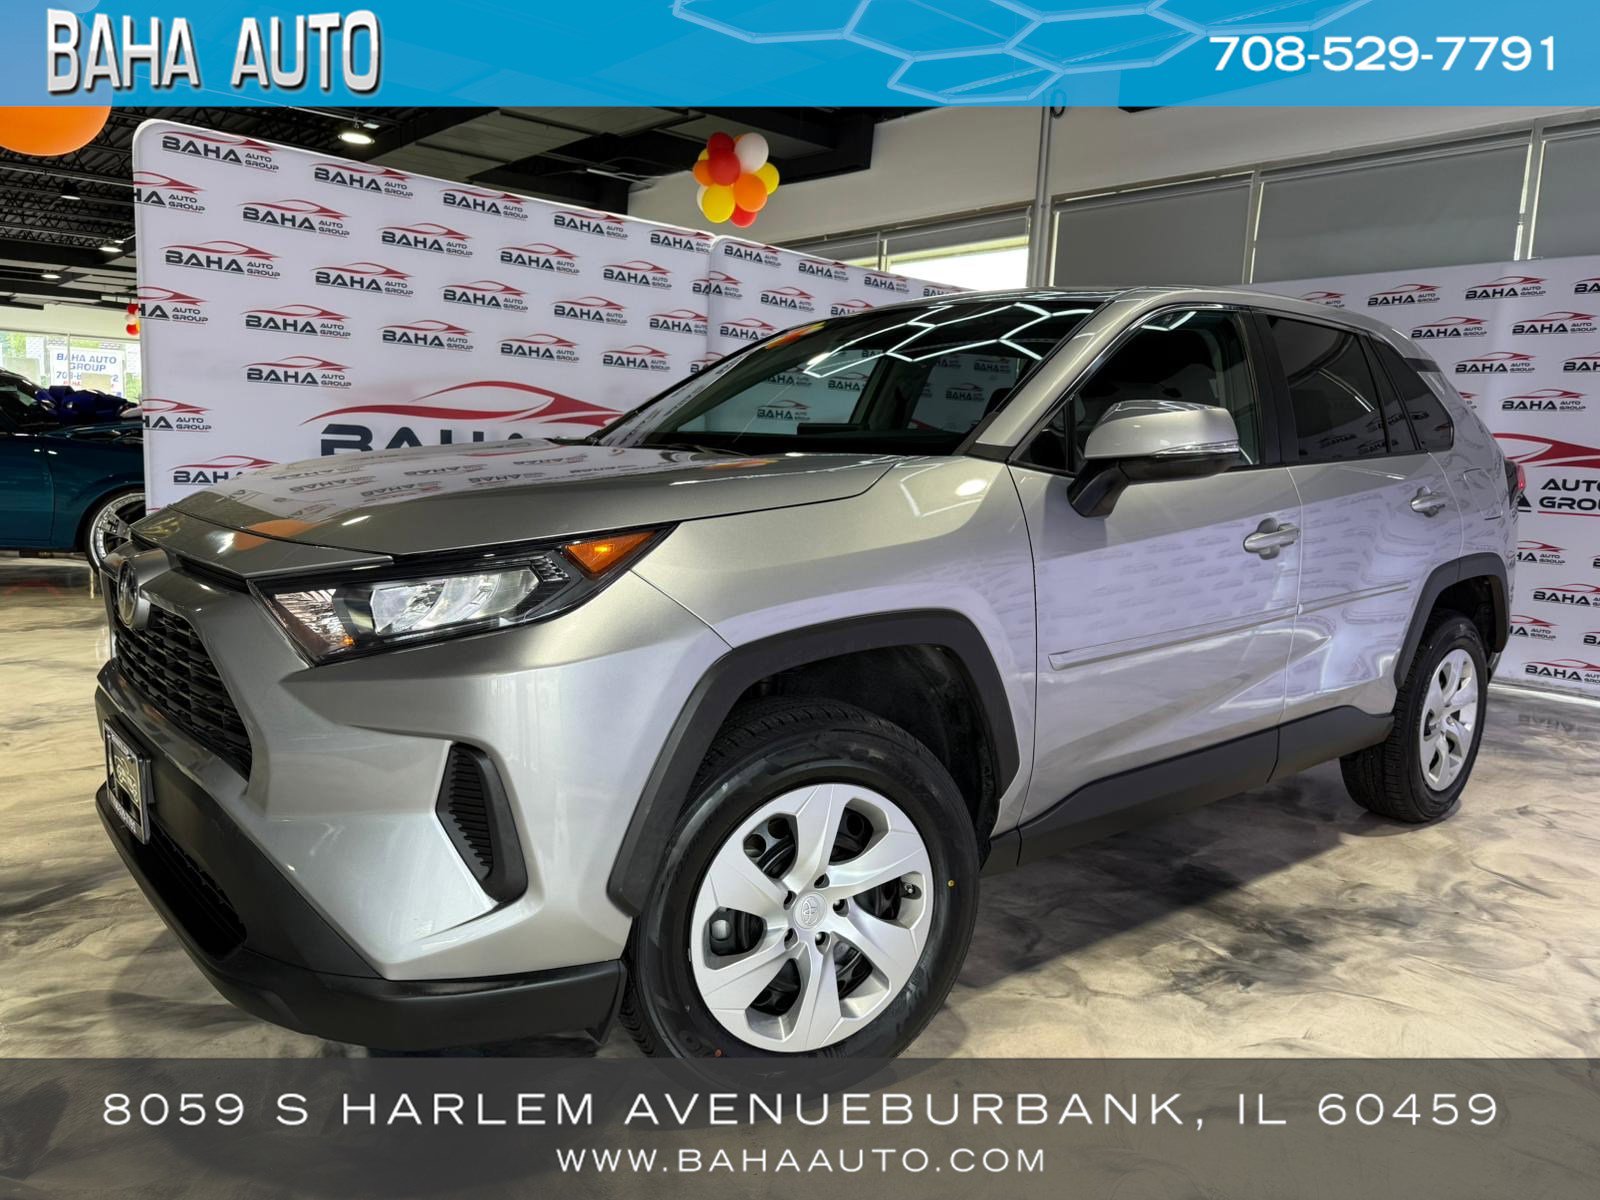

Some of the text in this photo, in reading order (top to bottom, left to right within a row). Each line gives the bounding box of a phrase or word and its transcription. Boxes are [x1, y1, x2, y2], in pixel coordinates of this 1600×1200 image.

[163, 136, 242, 163] BAHA
[245, 153, 272, 162] AUTO
[245, 160, 279, 171] GROUP
[314, 167, 382, 191] BAHA
[384, 182, 407, 190] AUTO
[384, 188, 413, 197] GROUP
[168, 194, 197, 203] AUTO
[443, 193, 501, 214] BAHA
[168, 202, 205, 213] GROUP
[243, 207, 316, 231] BAHA
[503, 211, 528, 220] GROUP
[318, 220, 343, 229] AUTO
[554, 215, 604, 234] BAHA
[318, 227, 349, 236] GROUP
[606, 231, 628, 239] GROUP
[382, 231, 444, 251] BAHA
[650, 233, 694, 250] BAHA
[446, 248, 472, 256] GROUP
[724, 245, 763, 263] BAHA
[165, 250, 244, 272] BAHA
[247, 261, 273, 270] AUTO
[501, 251, 554, 270] BAHA
[557, 260, 575, 268] AUTO
[247, 268, 280, 278] GROUP
[556, 266, 580, 274] GROUP
[798, 262, 832, 278] BAHA
[315, 271, 382, 291] BAHA
[604, 268, 650, 285] BAHA
[864, 276, 894, 291] BAHA
[1574, 283, 1600, 293] BA
[384, 287, 413, 296] GROUP
[1465, 287, 1518, 299] BAHA
[444, 289, 501, 307] BAHA
[761, 294, 797, 309] BAHA
[1368, 294, 1416, 306] BAHA
[172, 307, 200, 315] AUTO
[503, 303, 528, 311] GROUP
[172, 314, 208, 322] GROUP
[554, 305, 604, 322] BAHA
[245, 314, 317, 334] BAHA
[650, 318, 692, 332] BAHA
[1512, 323, 1568, 334] BAHA
[320, 330, 351, 338] GROUP
[720, 323, 758, 340] BAHA
[1411, 327, 1462, 338] BAHA
[383, 330, 444, 347] BAHA
[501, 343, 554, 359] BAHA
[89, 356, 117, 364] AUTO
[603, 354, 648, 369] BAHA
[1455, 363, 1508, 373] BAHA
[1563, 362, 1600, 371] BAH
[247, 368, 319, 385] BAHA
[321, 380, 352, 388] GROUP
[828, 380, 860, 391] BAHA
[1502, 400, 1557, 410] BAHA
[176, 416, 204, 424] AUTO
[757, 409, 793, 420] BAHA
[176, 423, 212, 431] GROUP
[173, 471, 242, 484] BAH
[1541, 478, 1600, 493] AUT
[1539, 497, 1600, 511] GRO
[1533, 591, 1590, 605] BAHA
[1525, 665, 1582, 681] BAHA
